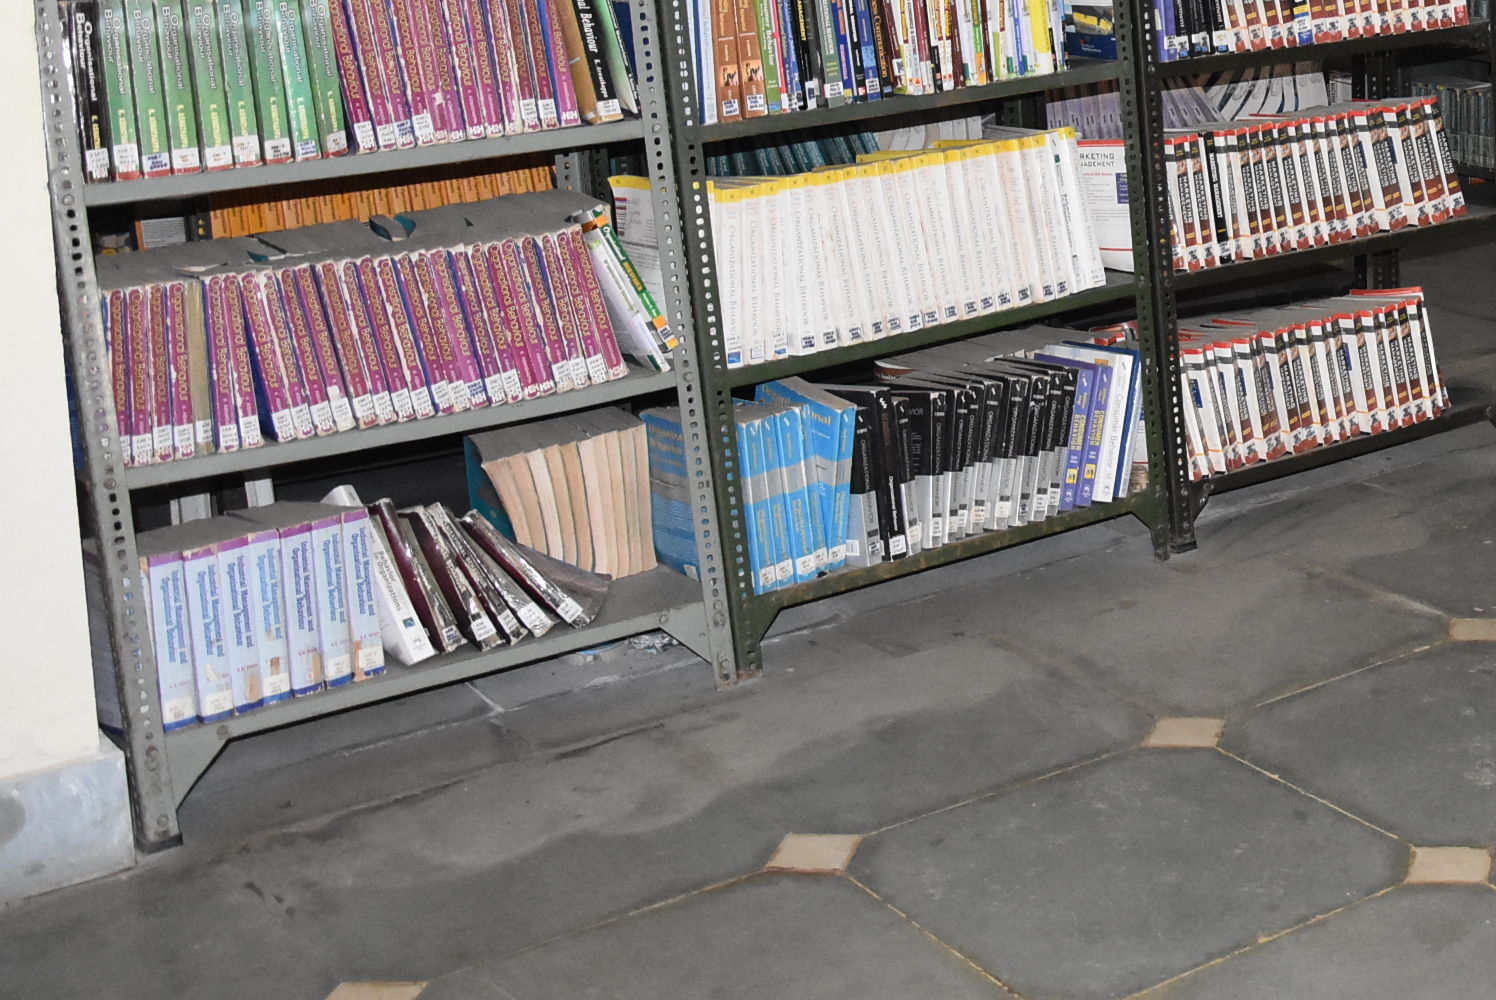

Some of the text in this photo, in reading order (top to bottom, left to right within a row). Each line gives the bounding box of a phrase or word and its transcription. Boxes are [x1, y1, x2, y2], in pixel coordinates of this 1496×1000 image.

[76, 13, 86, 68] Behaviour
[105, 10, 114, 62] Behaviour
[580, 12, 598, 52] Behaviour
[766, 29, 774, 66] Behavior
[874, 15, 888, 78] Communication
[84, 22, 97, 101] Organisational
[113, 18, 125, 94] Organisational
[406, 50, 420, 93] Behaviour
[1183, 176, 1193, 222] MARKETING
[795, 212, 808, 326] ORGANIZATIONAL BEHAVIOR
[852, 200, 876, 312] ORGANIZATIONAL BEHAVIOR
[1407, 336, 1418, 380] MARKETING
[982, 411, 994, 463] ORGANIZATIONAL
[1070, 414, 1080, 450] BEHAVIOR
[1076, 414, 1086, 450] CONSUMER
[1090, 410, 1100, 446] BEHAVIOR
[1095, 410, 1105, 446] CONSUMER
[1107, 394, 1124, 469] Consumer Behavior
[362, 558, 372, 603] Management
[376, 556, 402, 612] Organizations
[378, 550, 396, 582] Behavior
[296, 595, 304, 630] Behaviour
[304, 572, 312, 618] Management
[357, 583, 366, 615] Behaviour
